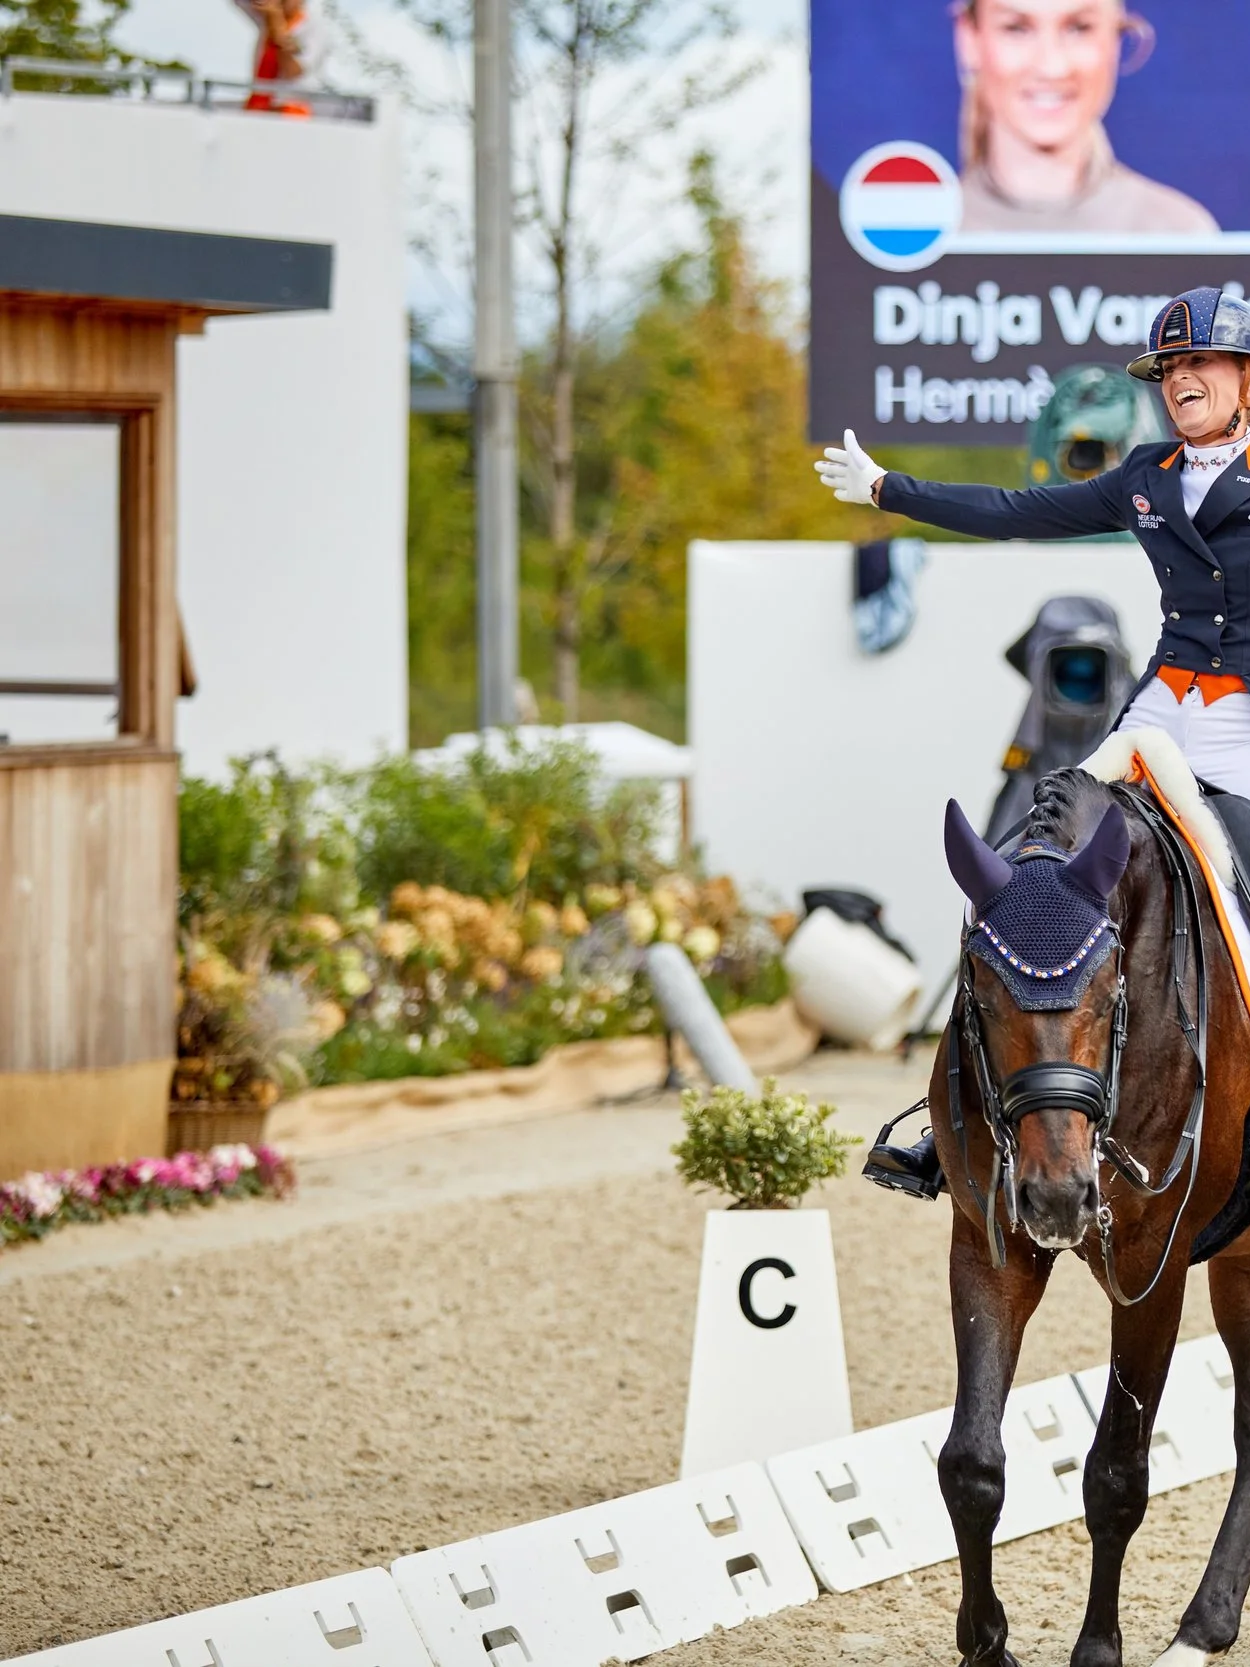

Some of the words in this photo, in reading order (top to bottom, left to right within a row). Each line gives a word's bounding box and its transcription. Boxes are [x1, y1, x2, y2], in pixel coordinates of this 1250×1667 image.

[873, 281, 1042, 363] Dinja
[874, 364, 1056, 424] Hermè
[1137, 514, 1166, 523] NEDERLAN
[739, 1257, 797, 1329] C
